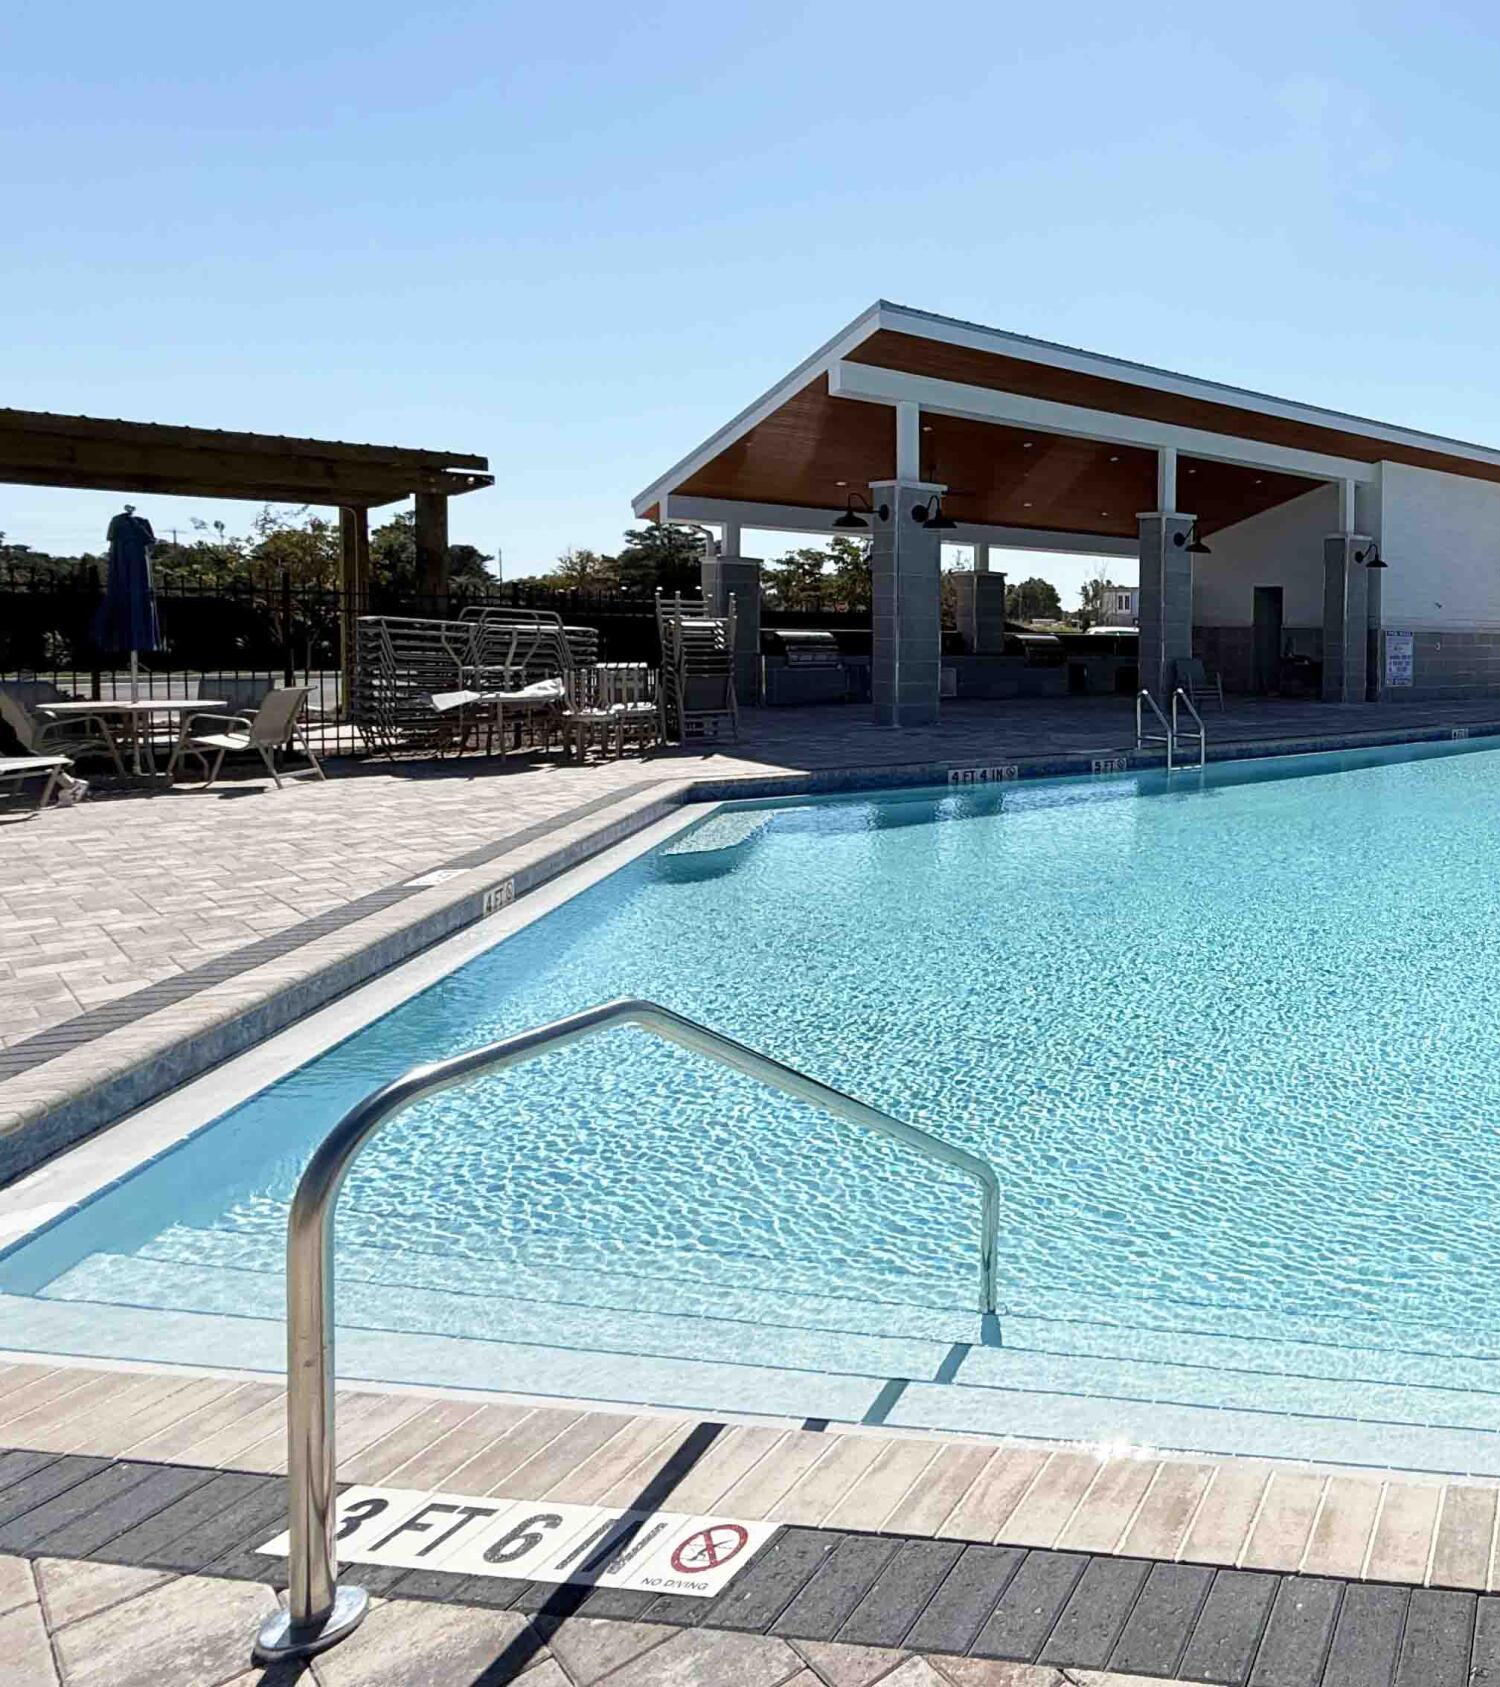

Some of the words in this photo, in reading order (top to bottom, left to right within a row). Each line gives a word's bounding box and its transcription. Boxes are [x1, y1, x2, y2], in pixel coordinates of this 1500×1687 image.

[952, 771, 959, 785] 4
[964, 770, 976, 784] FT
[980, 769, 987, 783] 4
[992, 767, 1003, 782] IN
[1094, 761, 1101, 775] 5
[1104, 760, 1114, 774] FT
[486, 893, 492, 912] 4
[494, 887, 504, 909] FT
[336, 1498, 389, 1541] 3
[367, 1503, 499, 1557] FT
[483, 1513, 563, 1564] 6
[554, 1518, 669, 1575] IN
[641, 1577, 663, 1587] NO
[664, 1579, 709, 1591] DIVING
